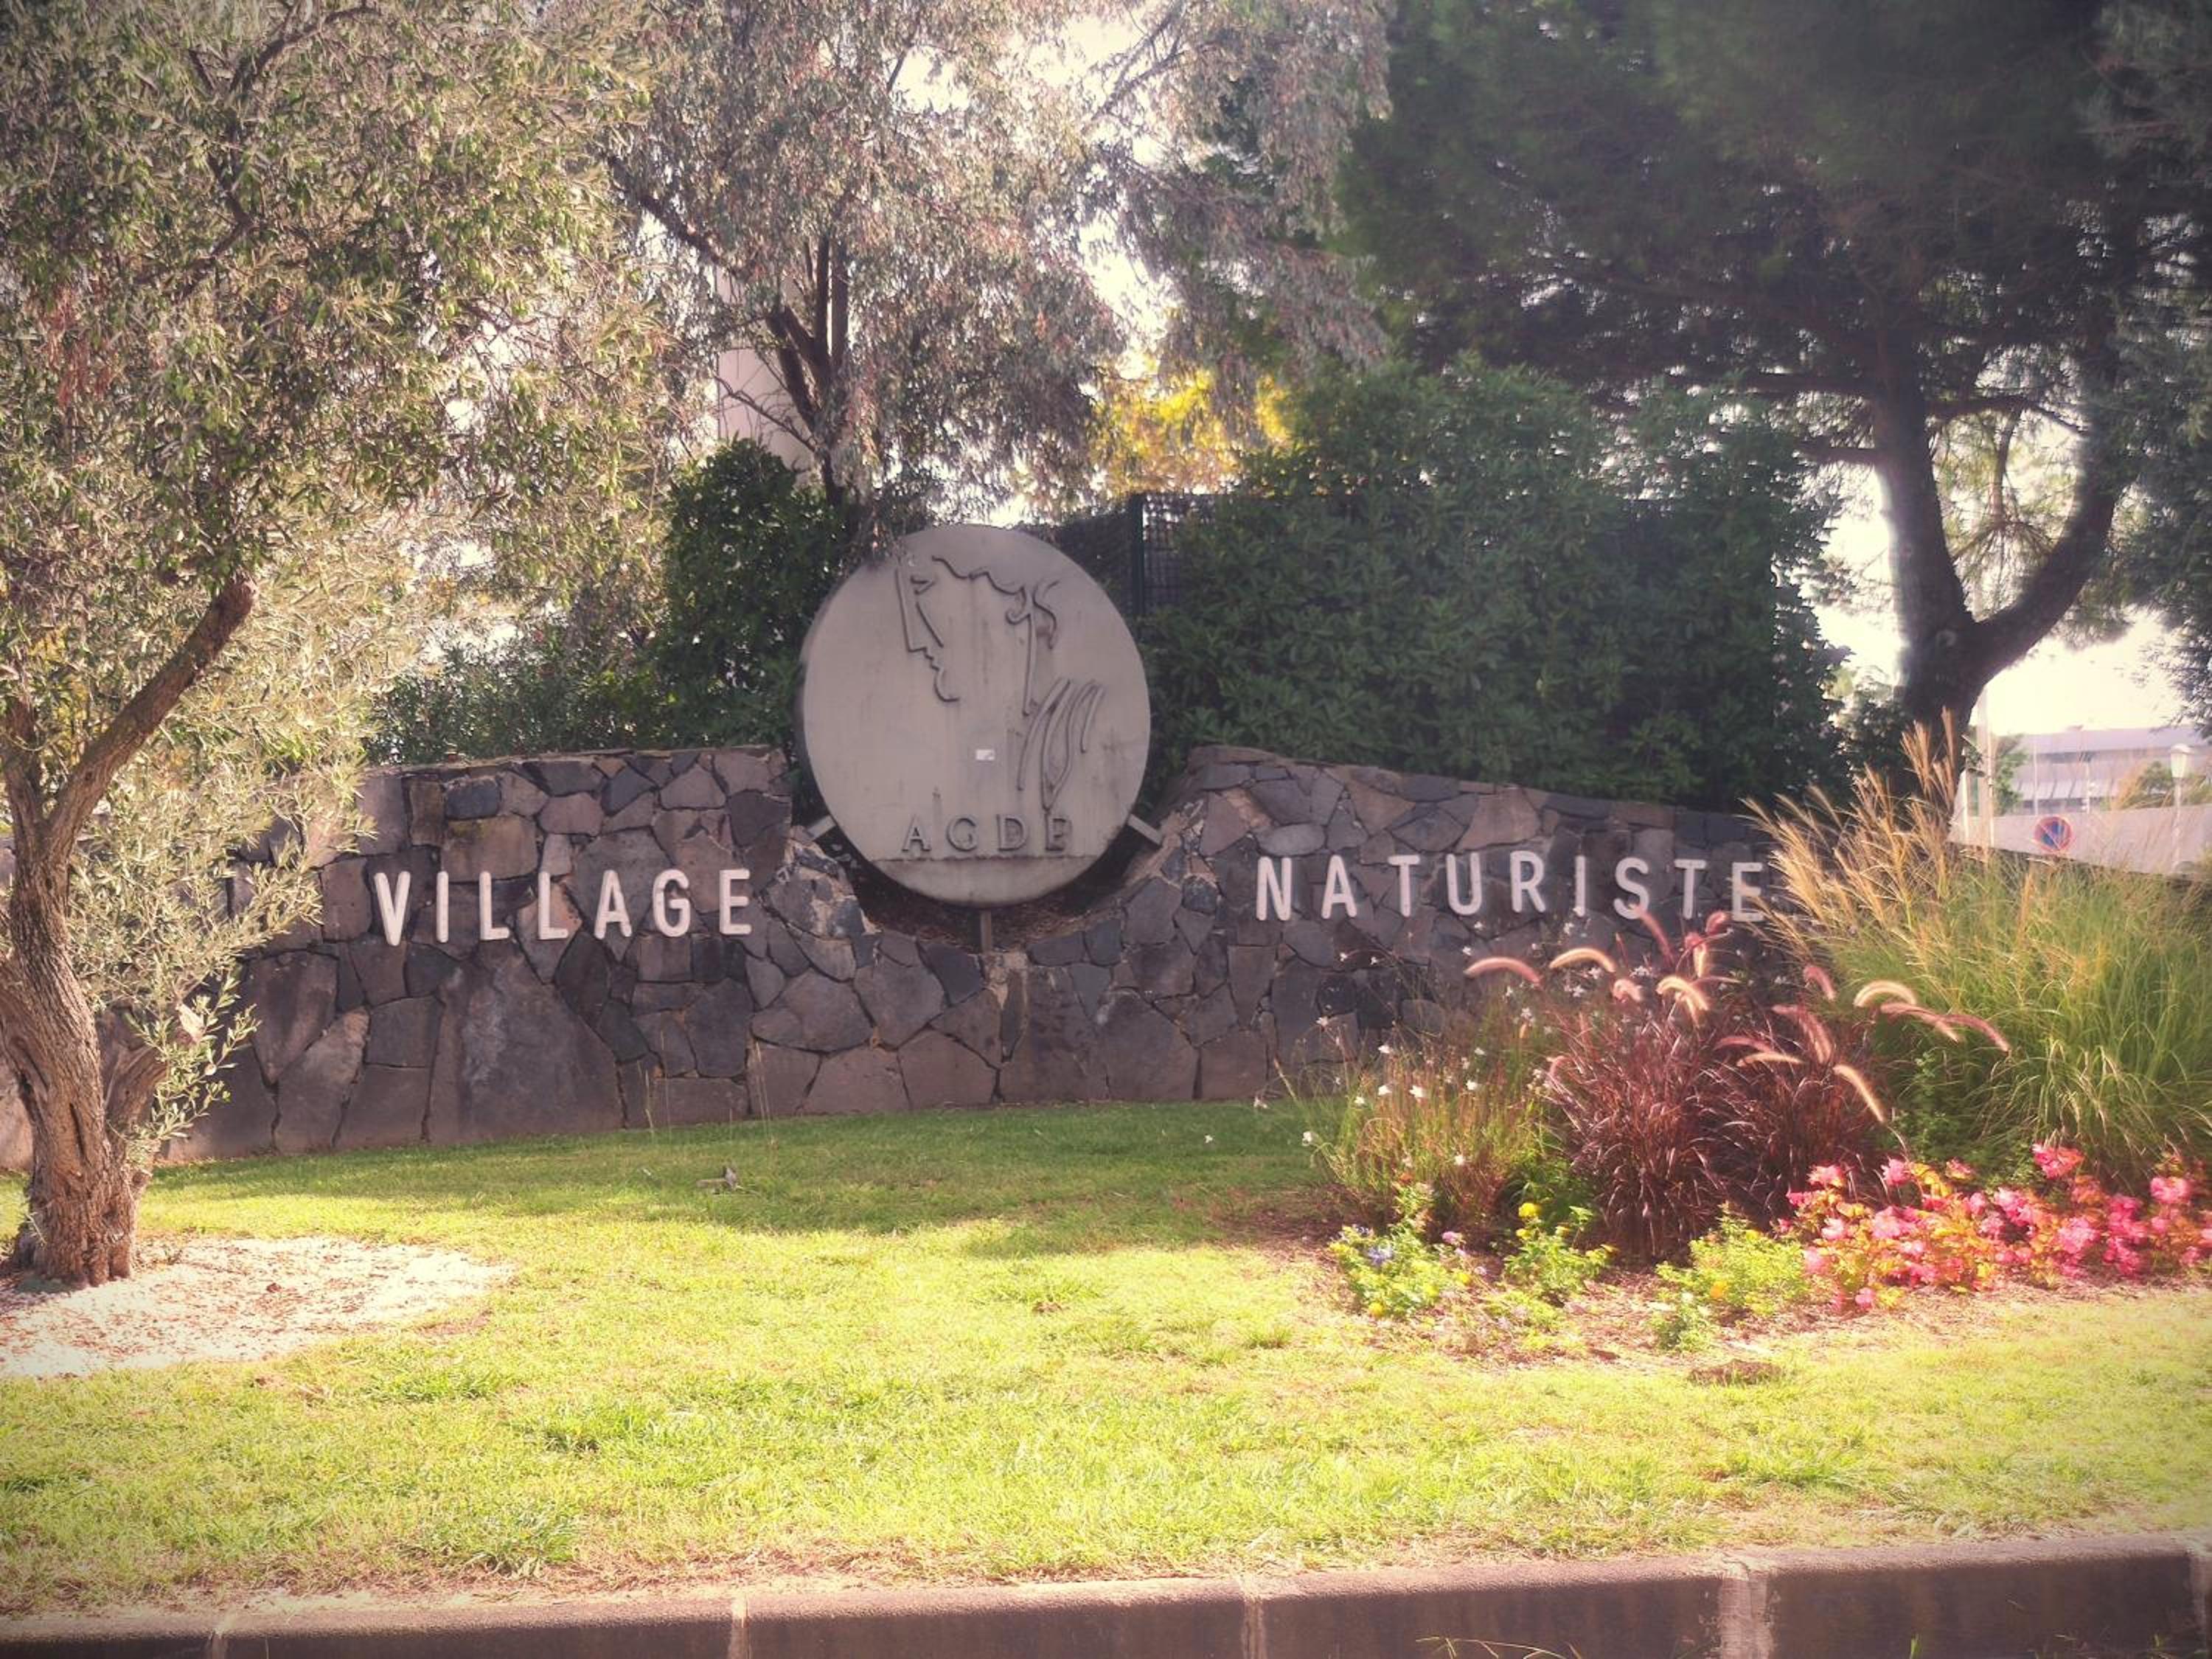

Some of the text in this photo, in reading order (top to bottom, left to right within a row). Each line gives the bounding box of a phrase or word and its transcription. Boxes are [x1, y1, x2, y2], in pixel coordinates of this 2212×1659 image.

[901, 812, 1073, 853] AGDE
[374, 869, 752, 946] VILLAGE
[1256, 850, 1764, 922] NATURISTE
